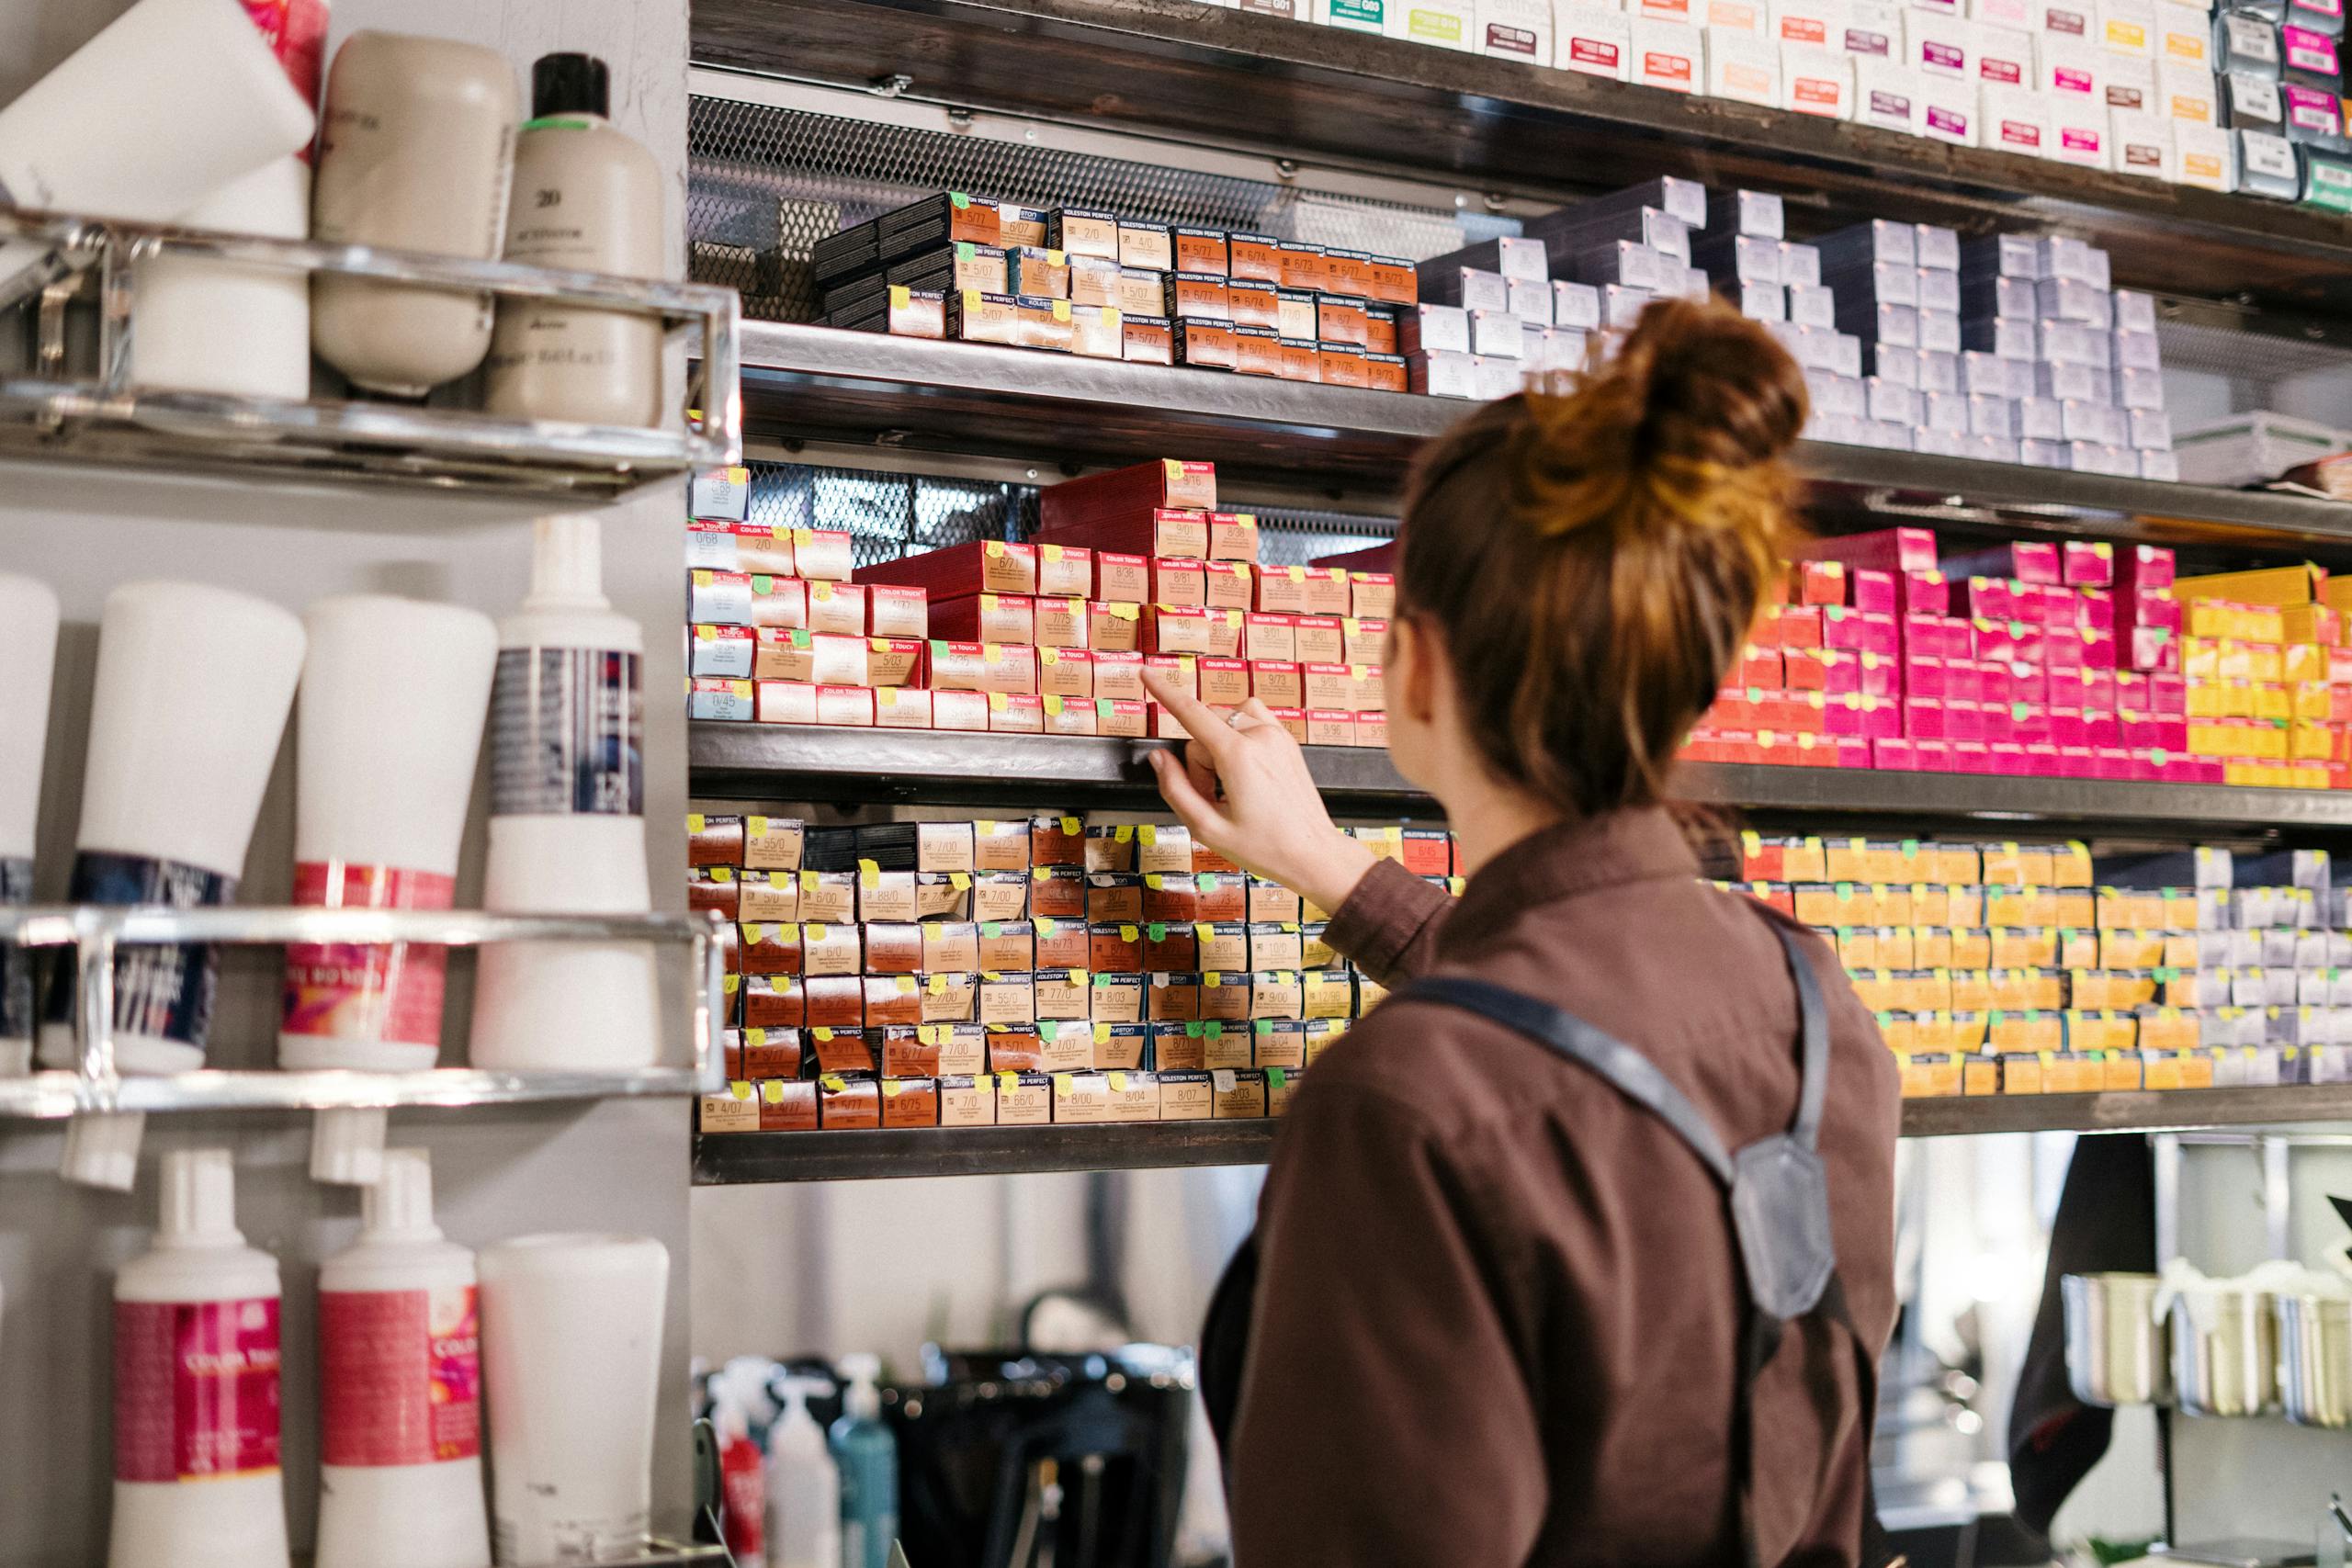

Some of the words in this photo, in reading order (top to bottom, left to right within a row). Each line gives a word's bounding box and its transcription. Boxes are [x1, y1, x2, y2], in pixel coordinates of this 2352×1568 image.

[978, 197, 998, 206] PERFECT
[1064, 209, 1090, 219] KOLESTON
[1092, 211, 1114, 220] PERFECT
[1121, 221, 1146, 230] KOLESTON
[1178, 228, 1203, 237] KOLESTON
[1204, 231, 1224, 239] PERFECT
[1232, 233, 1256, 243] KOLESTON
[1259, 237, 1277, 245] PERFECT
[984, 249, 1005, 257] PERFECT
[1281, 243, 1305, 252] KOLESTON
[1306, 245, 1325, 254] PERFECT
[922, 291, 943, 299] PERFECT
[1290, 295, 1312, 303] PERFECT
[1320, 297, 1343, 305] KOLESTON
[1123, 316, 1148, 324] KOLESTON
[1150, 318, 1170, 326] PERFECT
[1187, 318, 1211, 326] KOLESTON
[1213, 320, 1235, 328] PERFECT
